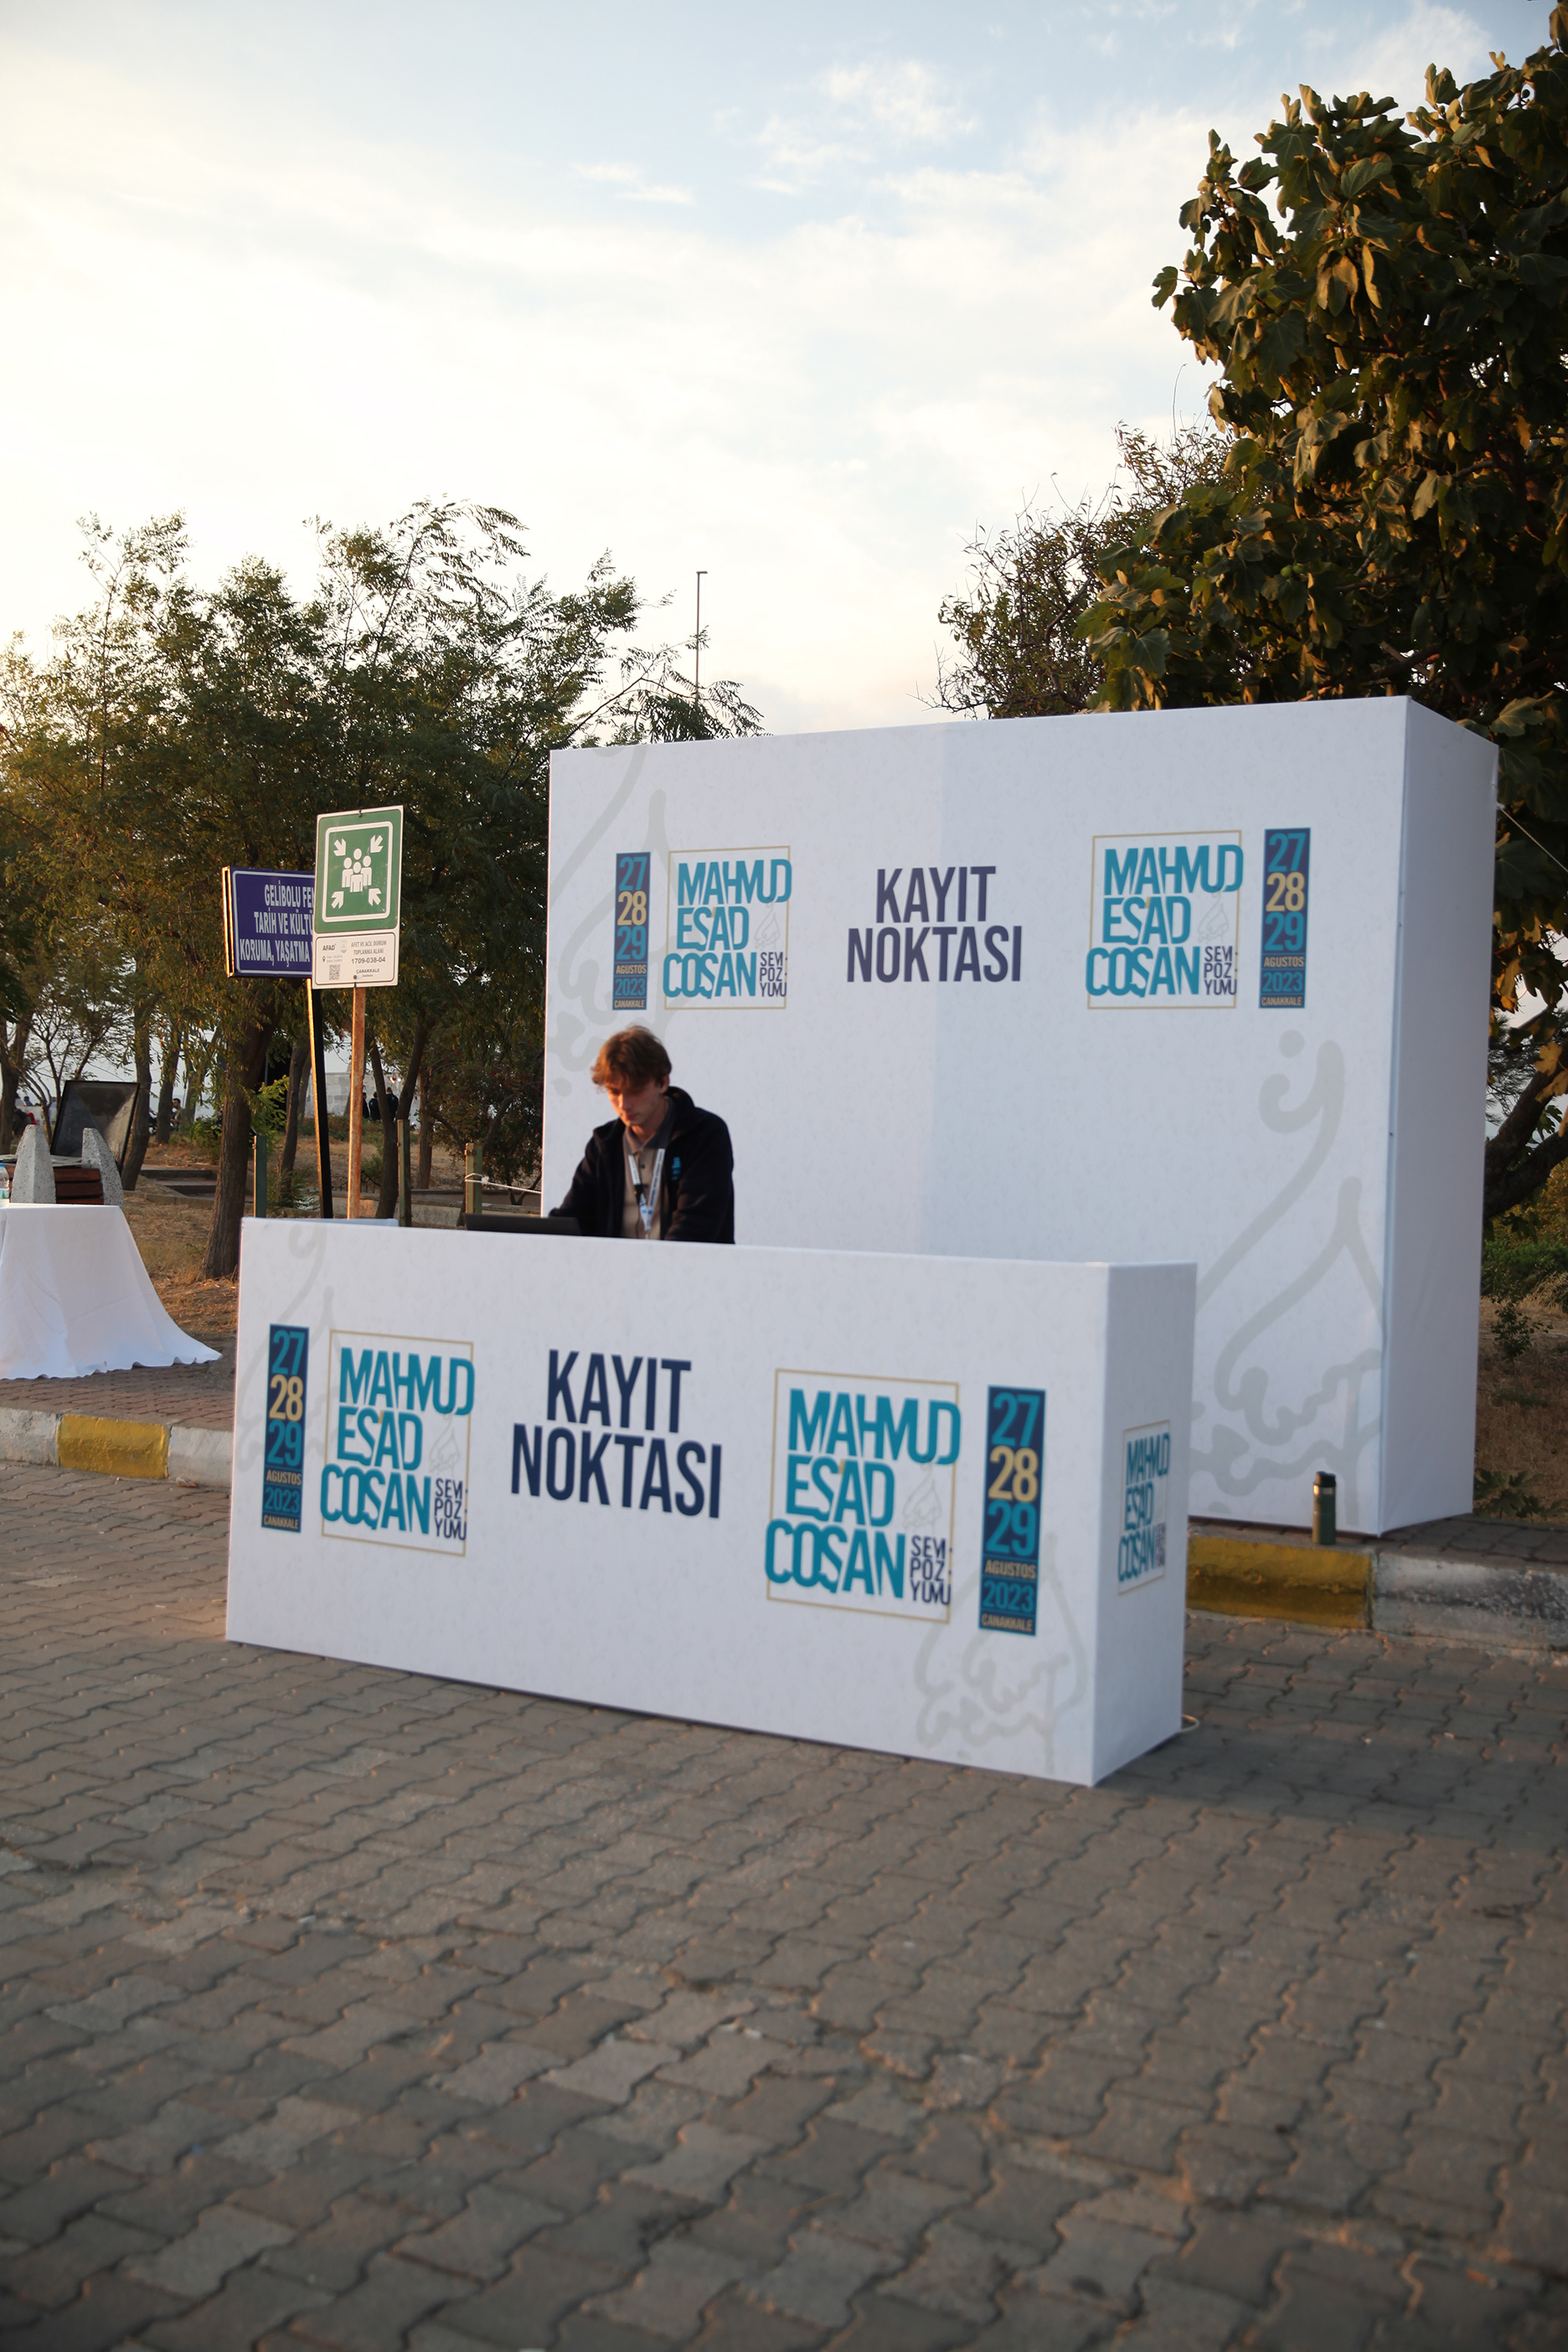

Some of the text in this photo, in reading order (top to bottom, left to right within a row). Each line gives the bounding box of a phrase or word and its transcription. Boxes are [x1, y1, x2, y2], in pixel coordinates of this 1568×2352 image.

[1103, 844, 1244, 895] MAHMUD
[1267, 833, 1307, 872] 27
[265, 879, 301, 907] GELİBOLU
[619, 856, 647, 891] 27
[678, 859, 792, 905] MAHMUD
[1266, 872, 1305, 911] 28
[617, 890, 647, 926] 28
[876, 865, 996, 923] KAYIT
[254, 907, 277, 934] TARİH
[278, 912, 289, 934] VE
[1264, 911, 1304, 951] 29
[275, 940, 311, 967] YAŞATMA
[616, 926, 647, 960] 29
[847, 925, 1022, 983] NOKTASI
[615, 977, 646, 996] 2023
[759, 983, 787, 997] YUMU
[1204, 979, 1237, 995] YUMU
[1261, 972, 1303, 993] 2023
[271, 1329, 306, 1377] 27
[269, 1374, 303, 1421] 28
[339, 1347, 475, 1416] MAHMUD
[547, 1349, 692, 1433] KAYIT
[788, 1388, 962, 1465] MAHMUD
[991, 1391, 1040, 1448] 27
[267, 1419, 302, 1466] 29
[1126, 1431, 1170, 1486] MAHMUD
[511, 1422, 722, 1519] NOKTASI
[988, 1445, 1039, 1503] 28
[265, 1486, 300, 1514] 2023
[434, 1517, 467, 1541] YUMU
[986, 1499, 1036, 1556] 29
[910, 1577, 952, 1606] YUMU
[983, 1580, 1034, 1612] 2023
